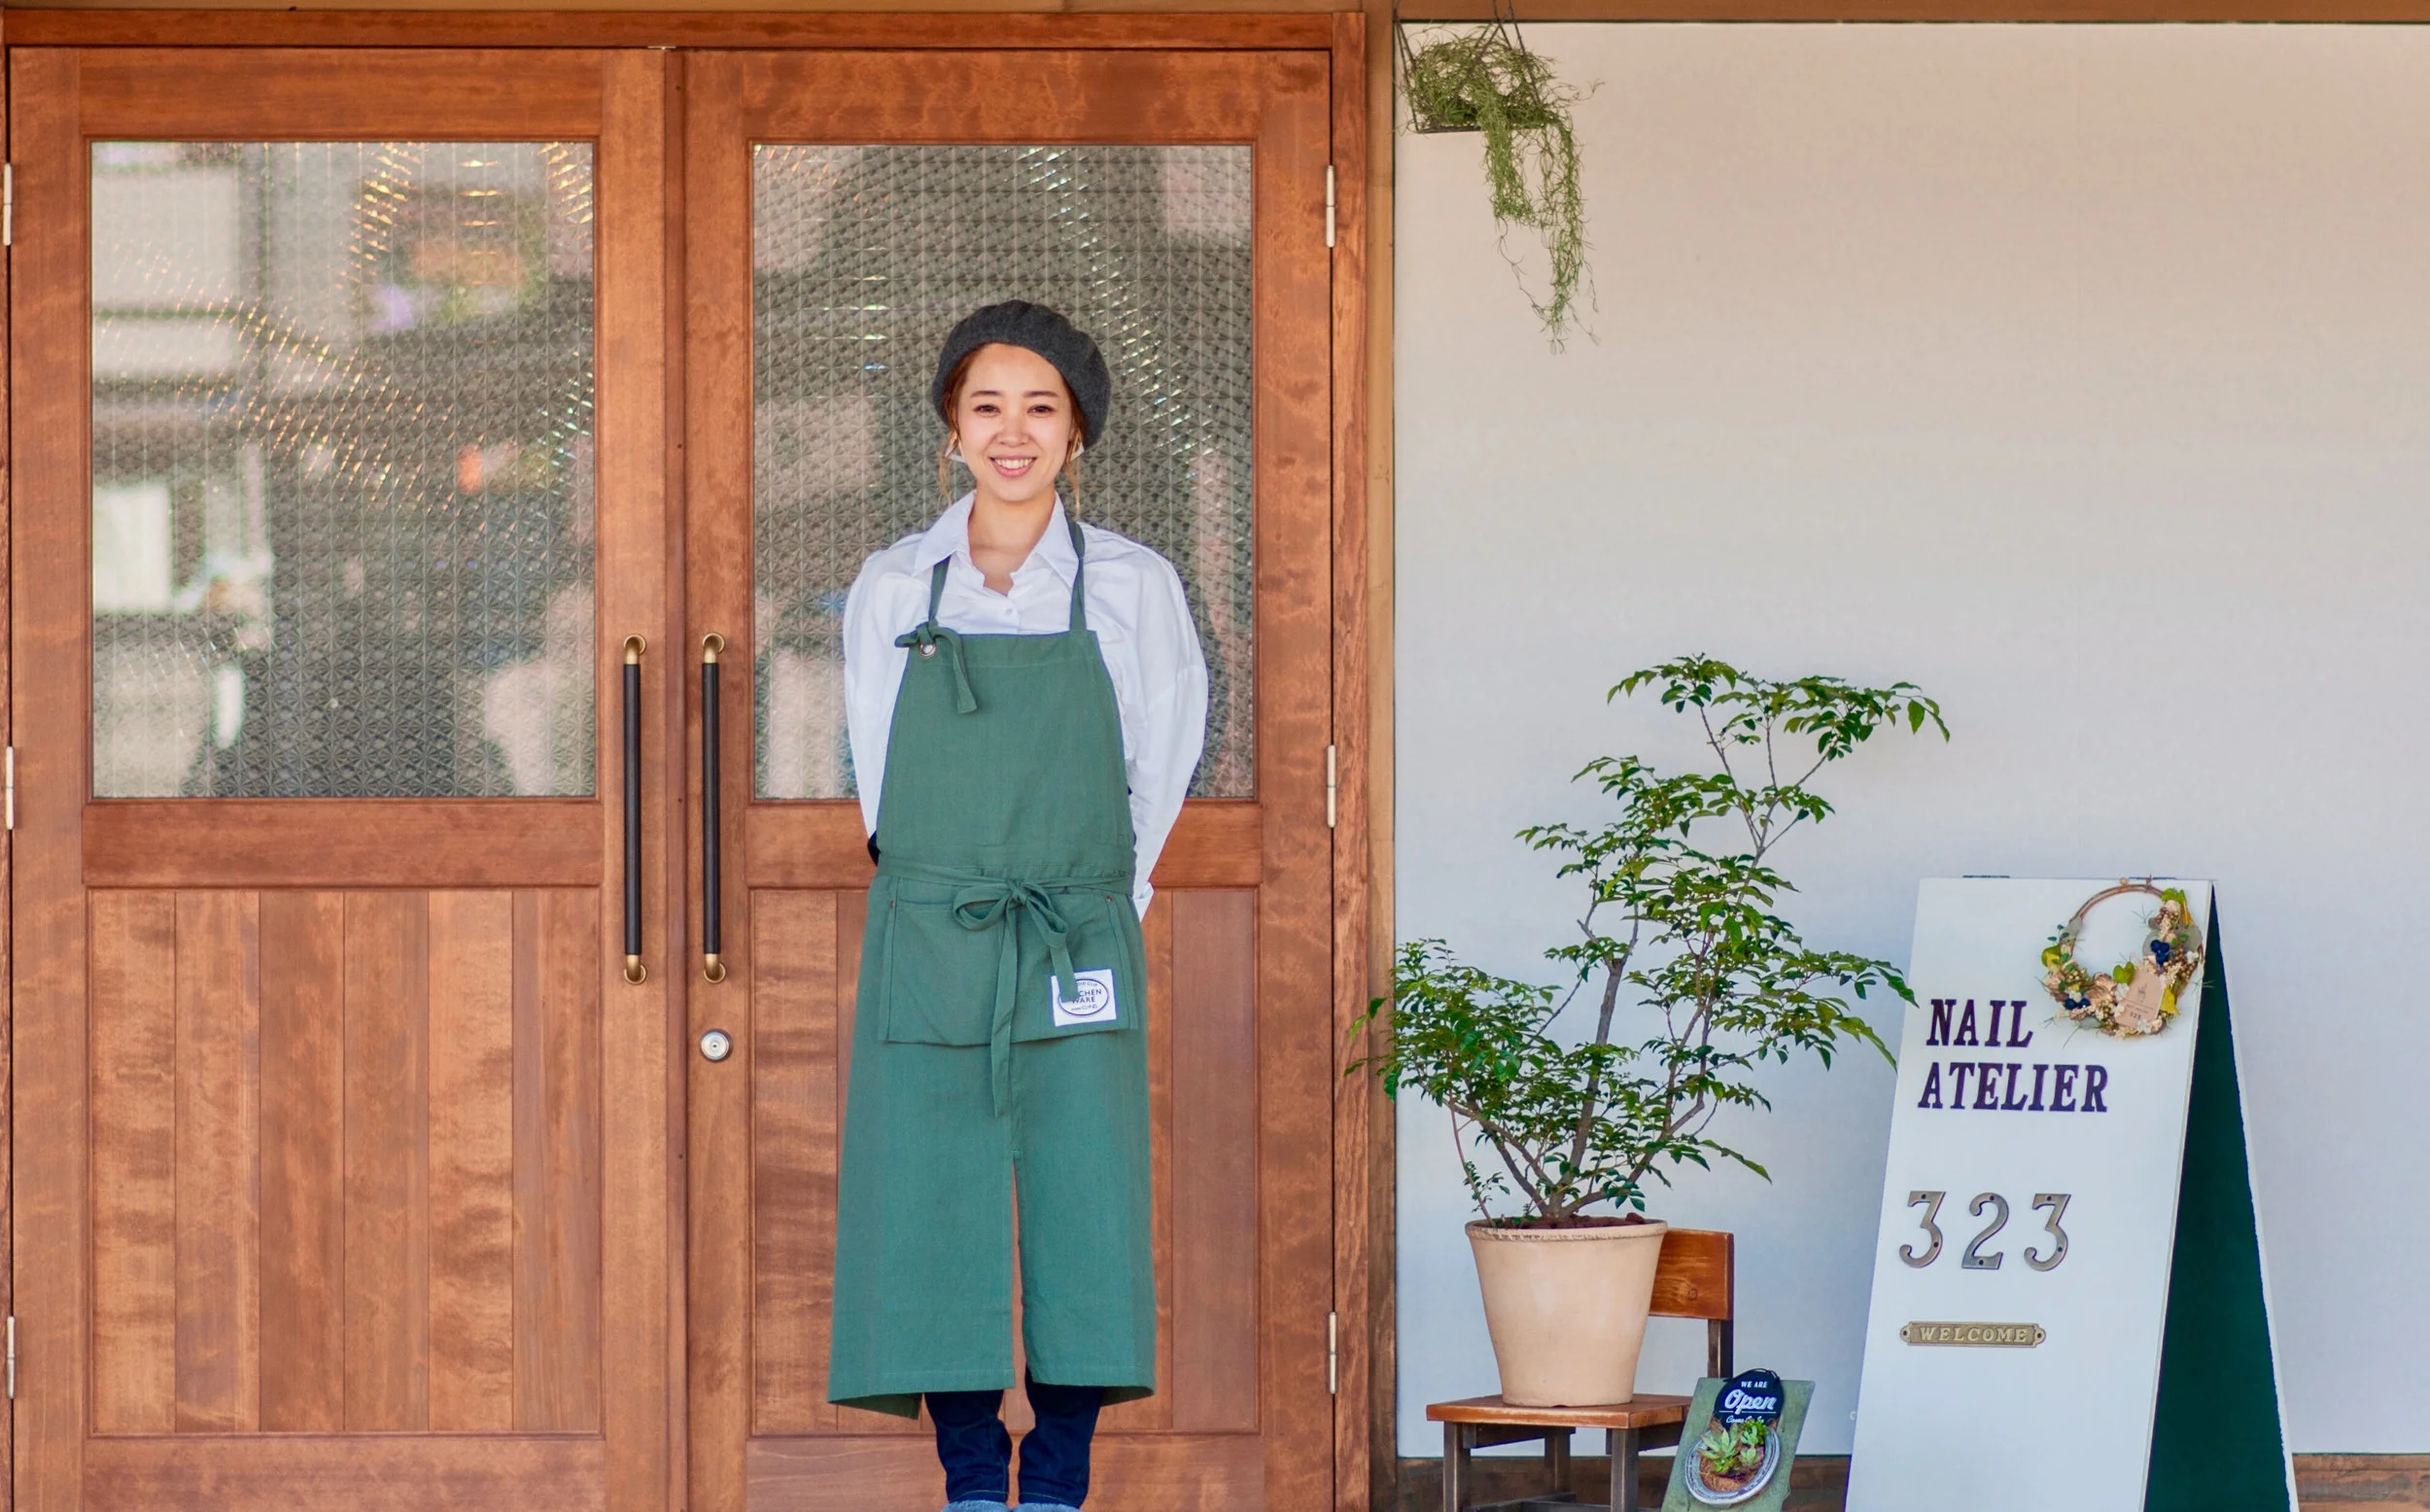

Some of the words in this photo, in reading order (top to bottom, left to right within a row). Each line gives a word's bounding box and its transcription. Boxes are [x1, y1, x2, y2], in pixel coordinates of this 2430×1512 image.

[1926, 999, 2033, 1048] NAIL
[1917, 1062, 2108, 1113] ATELIER
[1898, 1190, 2072, 1272] 323
[1919, 1326, 2029, 1344] WELCOME
[1724, 1389, 1777, 1415] Open
